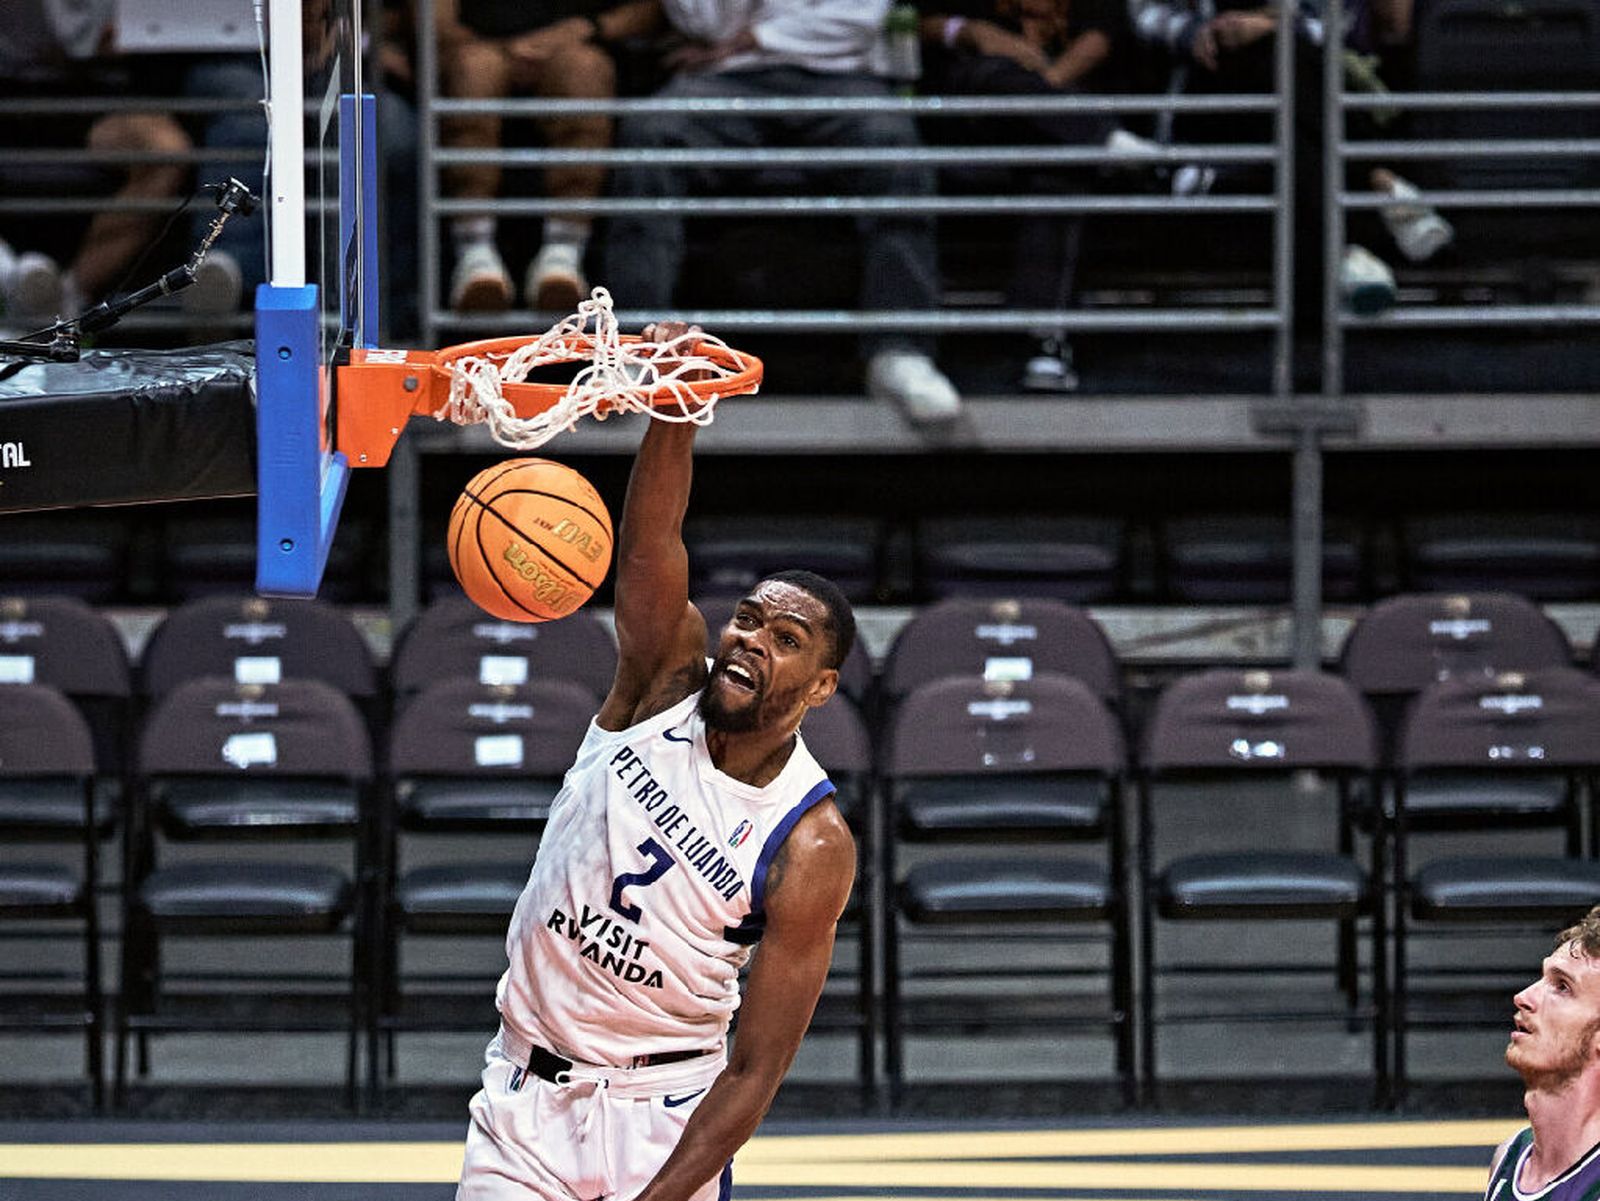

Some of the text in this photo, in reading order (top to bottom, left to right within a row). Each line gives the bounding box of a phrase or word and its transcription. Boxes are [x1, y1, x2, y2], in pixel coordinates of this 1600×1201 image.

[0, 441, 31, 468] AL
[609, 745, 744, 902] PETRO DE LUANDA
[609, 836, 677, 925] 2
[546, 908, 665, 989] RWANDA
[580, 904, 650, 961] VISIT
